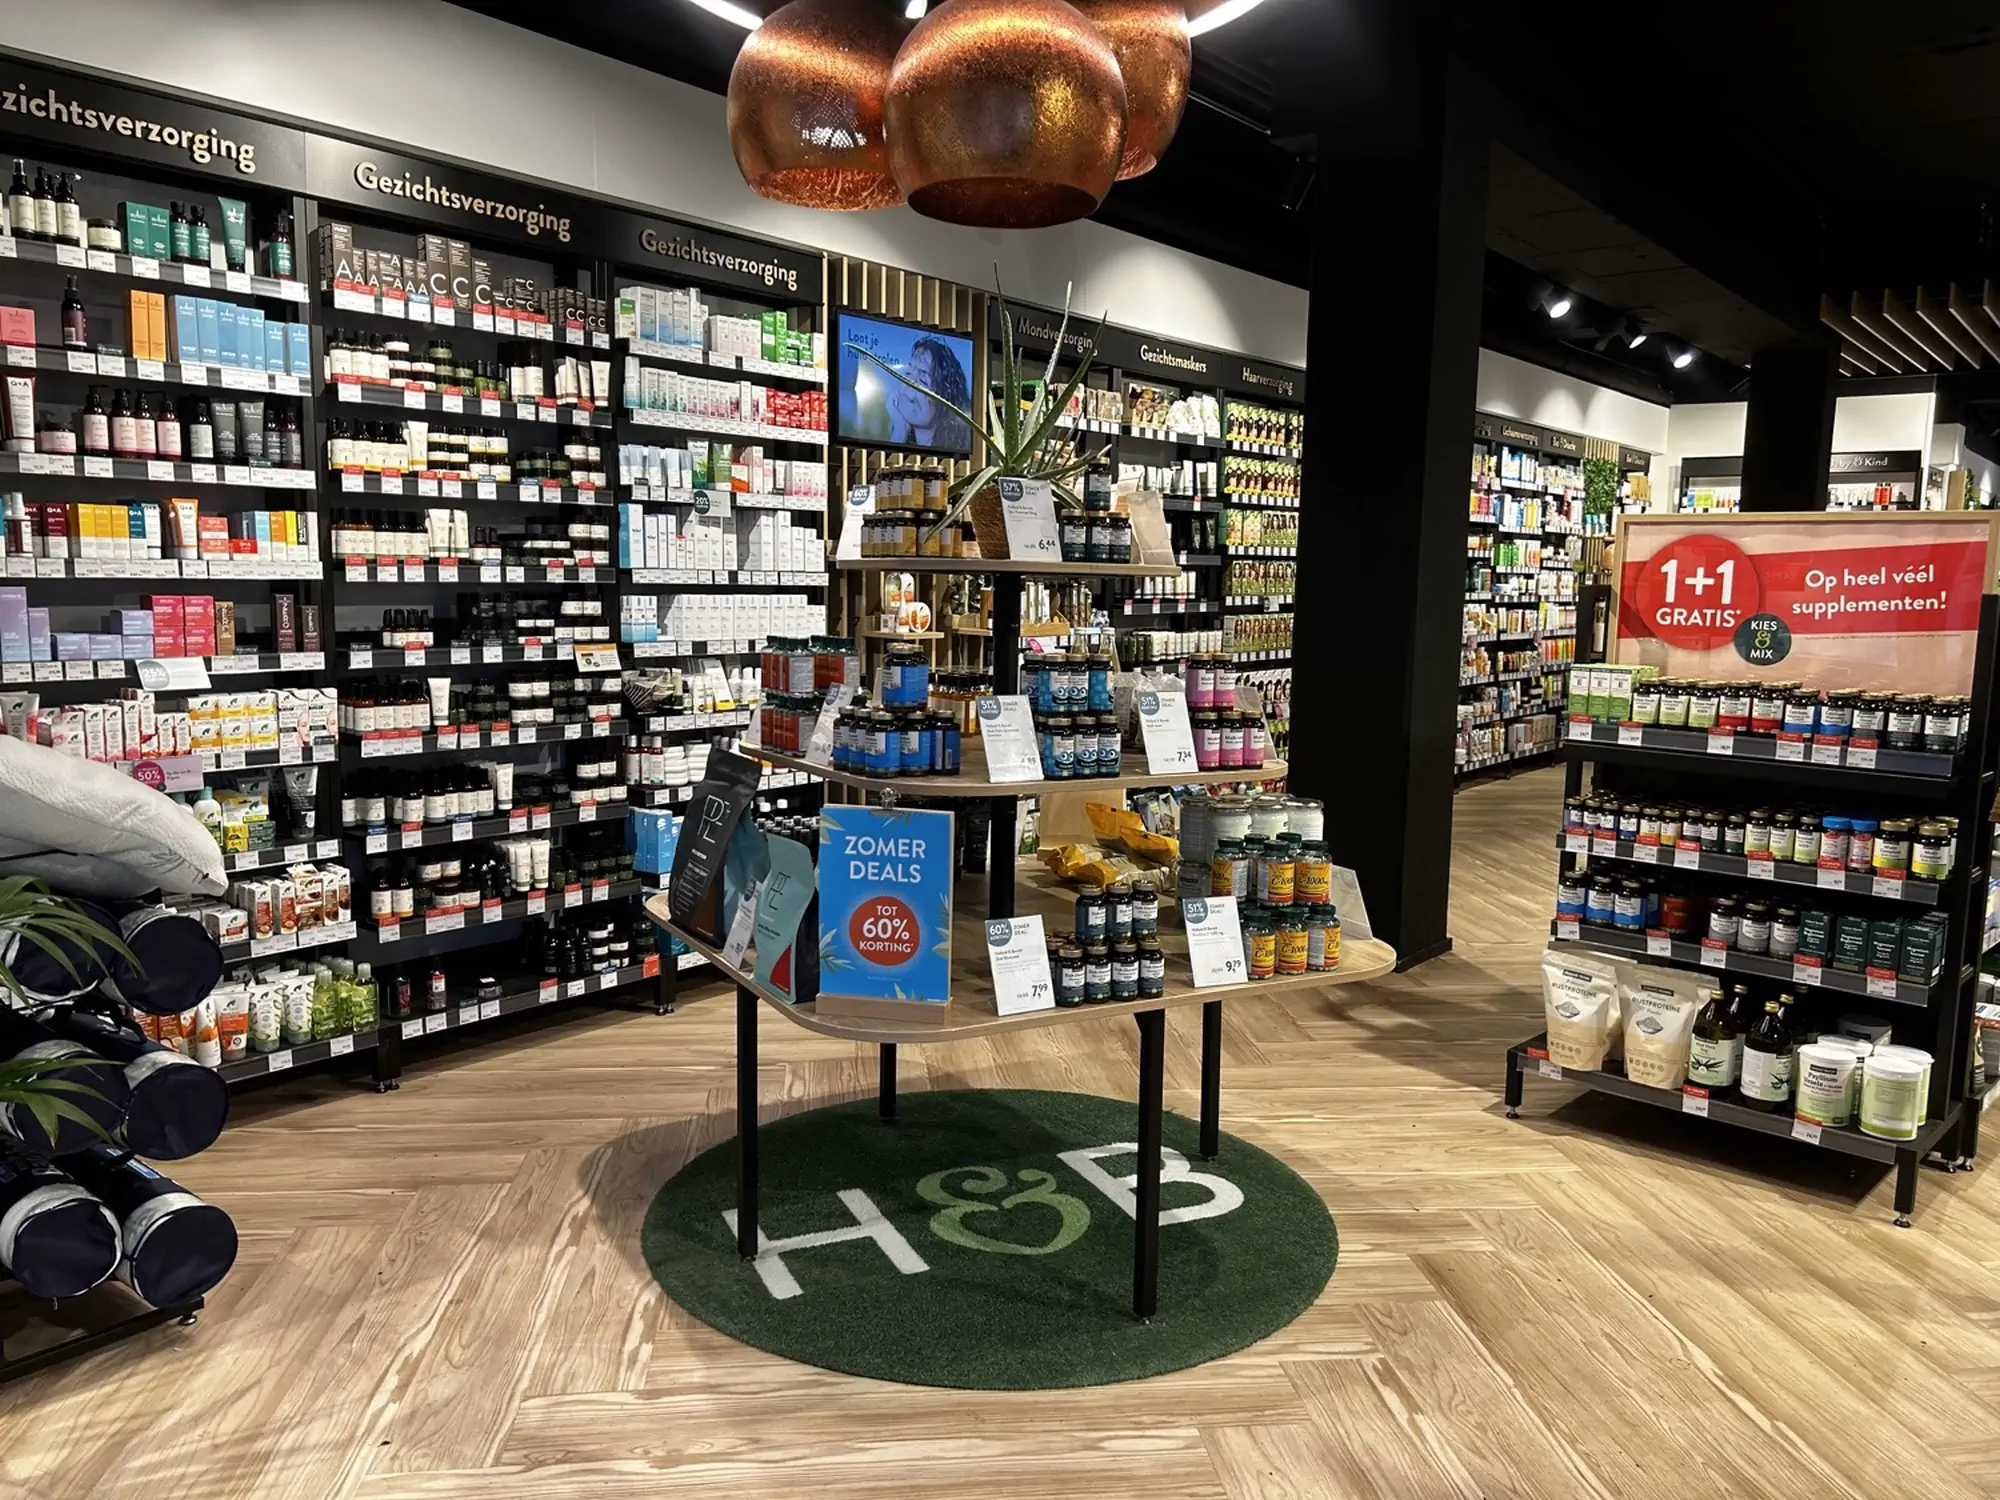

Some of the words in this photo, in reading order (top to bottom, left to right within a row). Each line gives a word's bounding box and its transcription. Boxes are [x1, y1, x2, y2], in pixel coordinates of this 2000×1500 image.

[0, 84, 256, 174] zichtsverzorging
[355, 162, 571, 242] Gezichtsverzorging
[391, 255, 401, 267] A
[641, 228, 798, 291] Gezichtsverzorging
[336, 259, 354, 279] A
[354, 272, 365, 285] A
[368, 274, 379, 287] A
[393, 278, 403, 289] A
[430, 272, 448, 294] C
[405, 281, 416, 292] A
[418, 283, 428, 295] A
[453, 277, 469, 298] C
[526, 280, 535, 290] C
[475, 284, 491, 304] C
[505, 297, 514, 308] C
[526, 301, 535, 311] C
[566, 308, 575, 320] C
[576, 310, 585, 321] C
[588, 316, 596, 326] C
[598, 318, 606, 328] C
[1018, 316, 1099, 356] Mondvezorgin
[868, 351, 900, 366] tralen
[1140, 344, 1207, 374] Gezichtsmaskers
[1242, 367, 1294, 396] Haarverzorging
[1864, 457, 1888, 466] Kind
[1003, 482, 1020, 493] 57%
[696, 496, 709, 505] 20%
[1038, 539, 1056, 551] 6,44
[1660, 559, 1736, 604] 1+1
[1805, 570, 1837, 593] Op
[1844, 567, 1886, 587] heel
[1892, 565, 1935, 585] véél
[1792, 591, 1947, 620] supplementen!
[1751, 620, 1778, 632] KIES
[1755, 631, 1771, 649] &
[1750, 649, 1773, 660] MIX
[142, 667, 166, 678] 25%
[981, 700, 997, 710] 51%
[1141, 696, 1156, 705] 51%
[1177, 751, 1192, 763] 7,34
[138, 770, 161, 782] 50%
[844, 836, 926, 859] ZOMER
[849, 861, 922, 883] DEALS
[876, 905, 898, 916] TOT
[1188, 902, 1203, 913] 51%
[862, 917, 910, 940] 60%
[990, 923, 1009, 935] 60%
[1032, 983, 1048, 999] 7,99
[722, 1141, 1246, 1300] H&B
